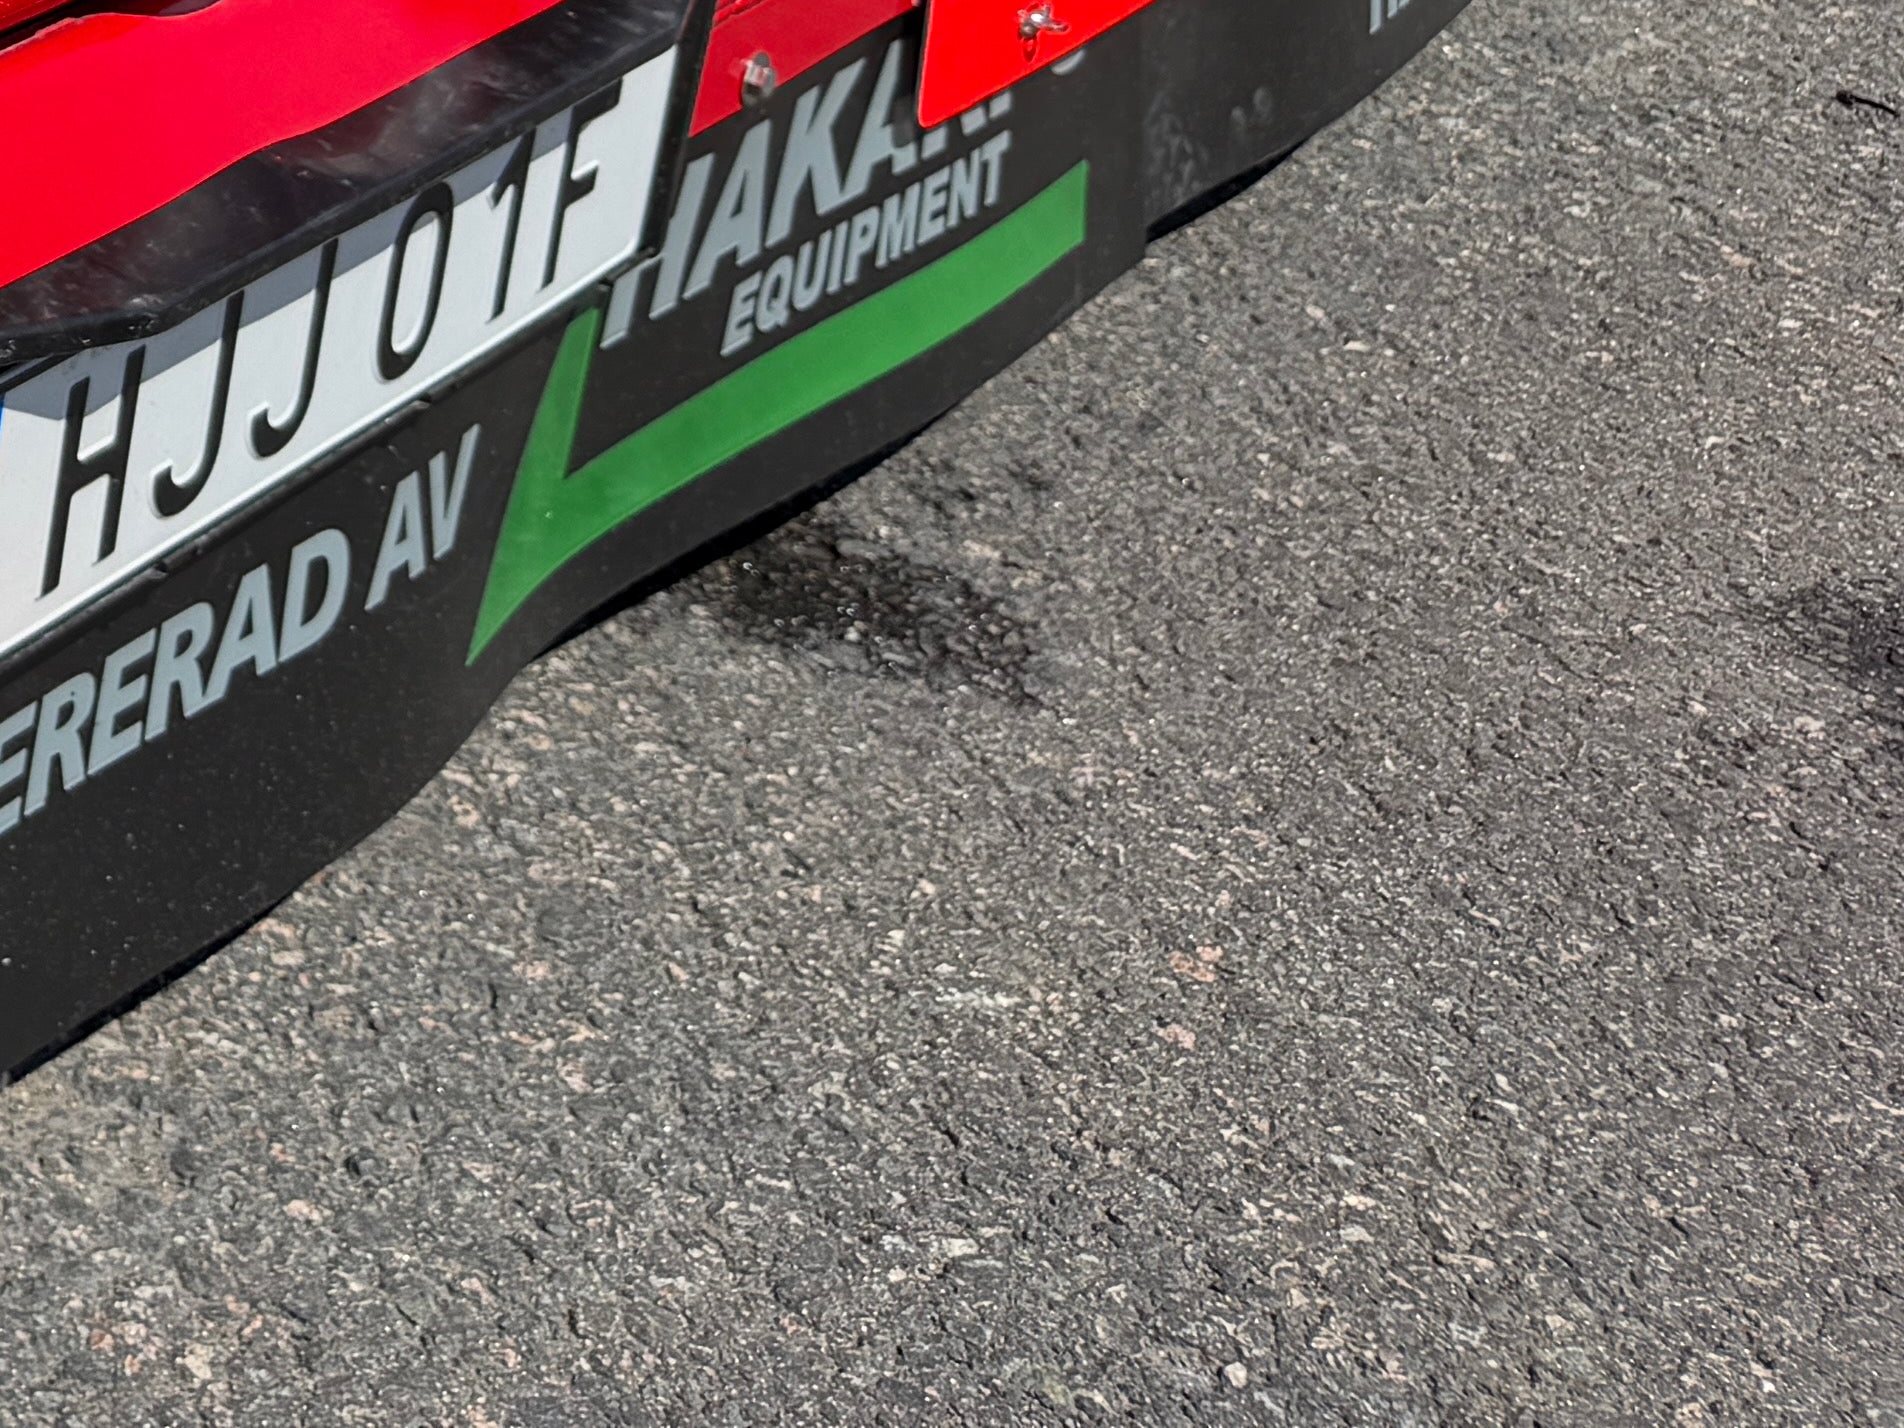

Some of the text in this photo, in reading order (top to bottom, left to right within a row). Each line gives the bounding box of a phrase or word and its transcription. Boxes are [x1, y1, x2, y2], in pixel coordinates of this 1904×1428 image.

[602, 39, 1086, 349] HAKA
[720, 129, 1012, 357] EQUIPMENT
[36, 78, 623, 601] HJJ 01F
[364, 423, 482, 611] AV
